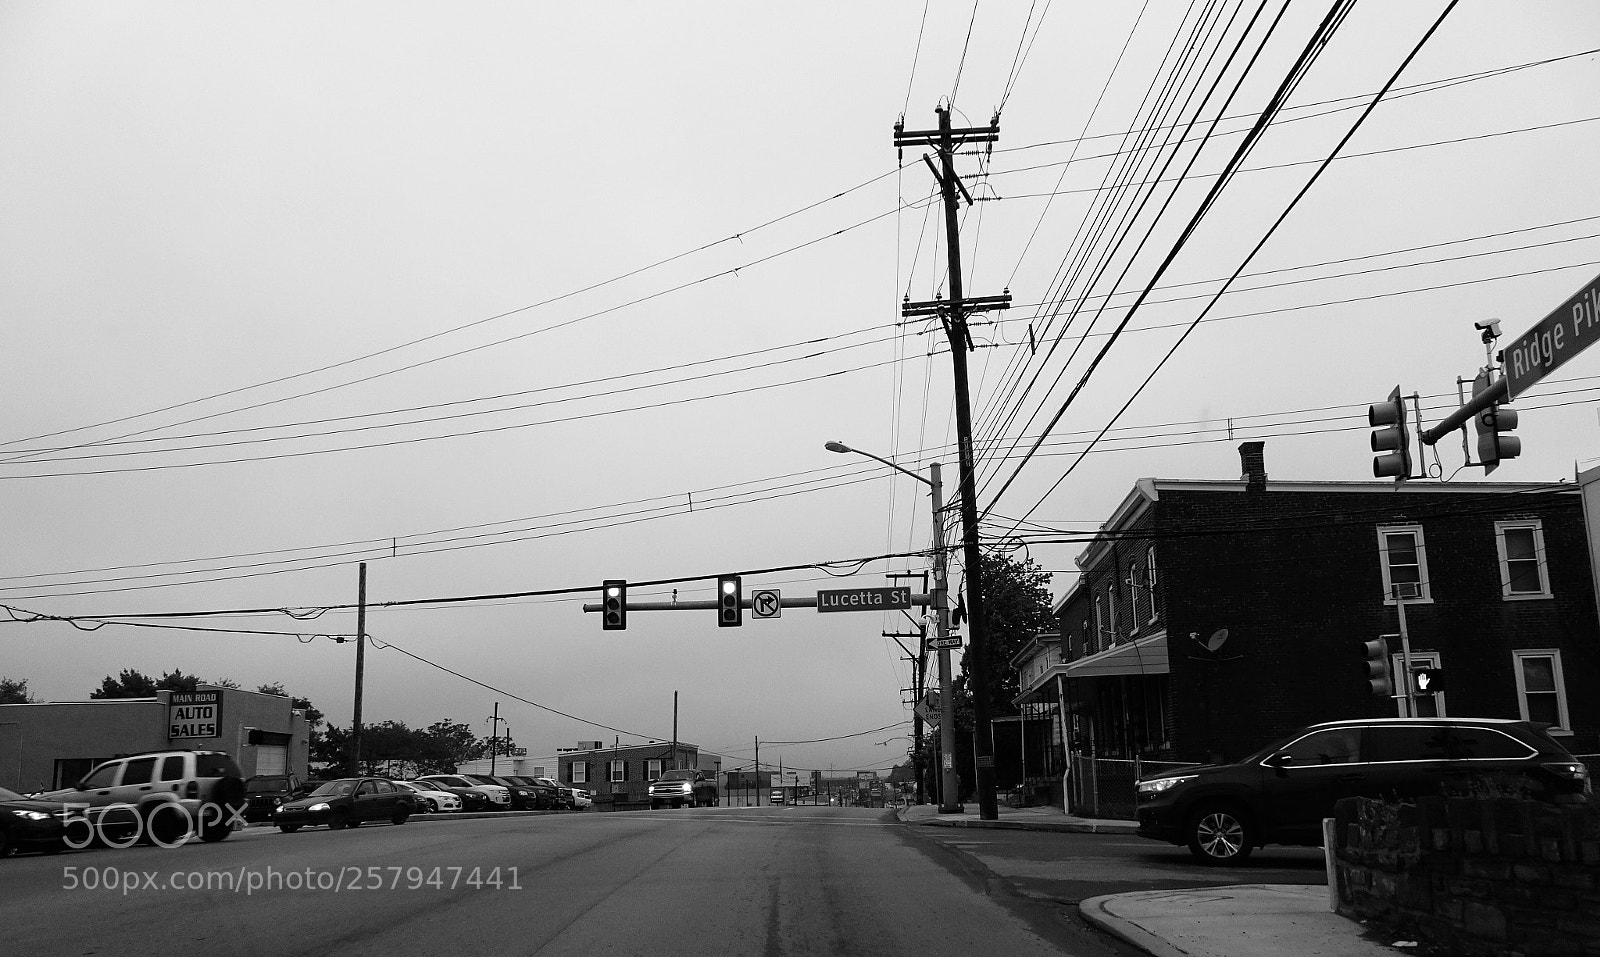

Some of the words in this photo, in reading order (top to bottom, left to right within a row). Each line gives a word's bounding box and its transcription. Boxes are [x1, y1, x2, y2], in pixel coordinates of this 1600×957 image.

[1513, 323, 1564, 379] Ridge
[821, 591, 883, 607] Lucetta
[891, 590, 907, 604] St
[173, 694, 193, 703] MAIN
[195, 693, 217, 702] ROAD
[175, 706, 213, 720] AUTO
[171, 723, 216, 737] SALES
